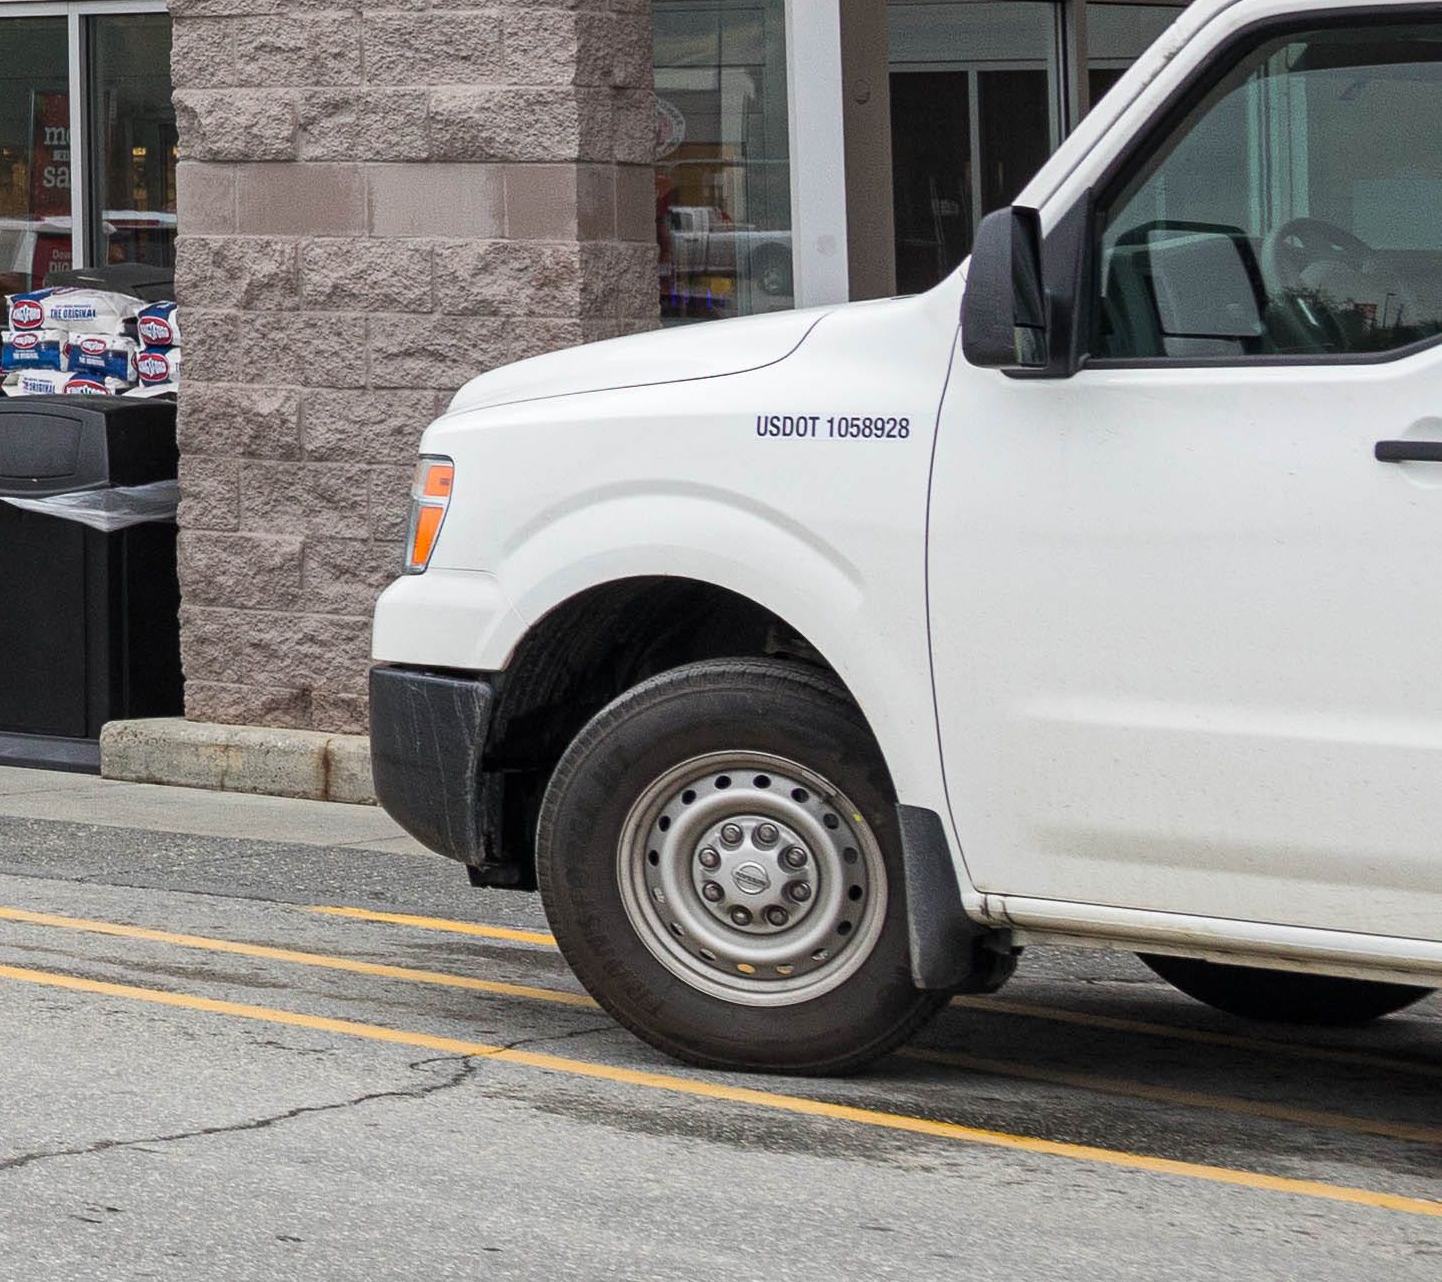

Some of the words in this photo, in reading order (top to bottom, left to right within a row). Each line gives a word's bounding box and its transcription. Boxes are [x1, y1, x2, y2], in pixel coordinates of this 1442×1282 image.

[43, 167, 71, 188] sa
[52, 250, 72, 259] Dow
[756, 415, 820, 438] USDOT
[827, 416, 910, 439] 1058928
